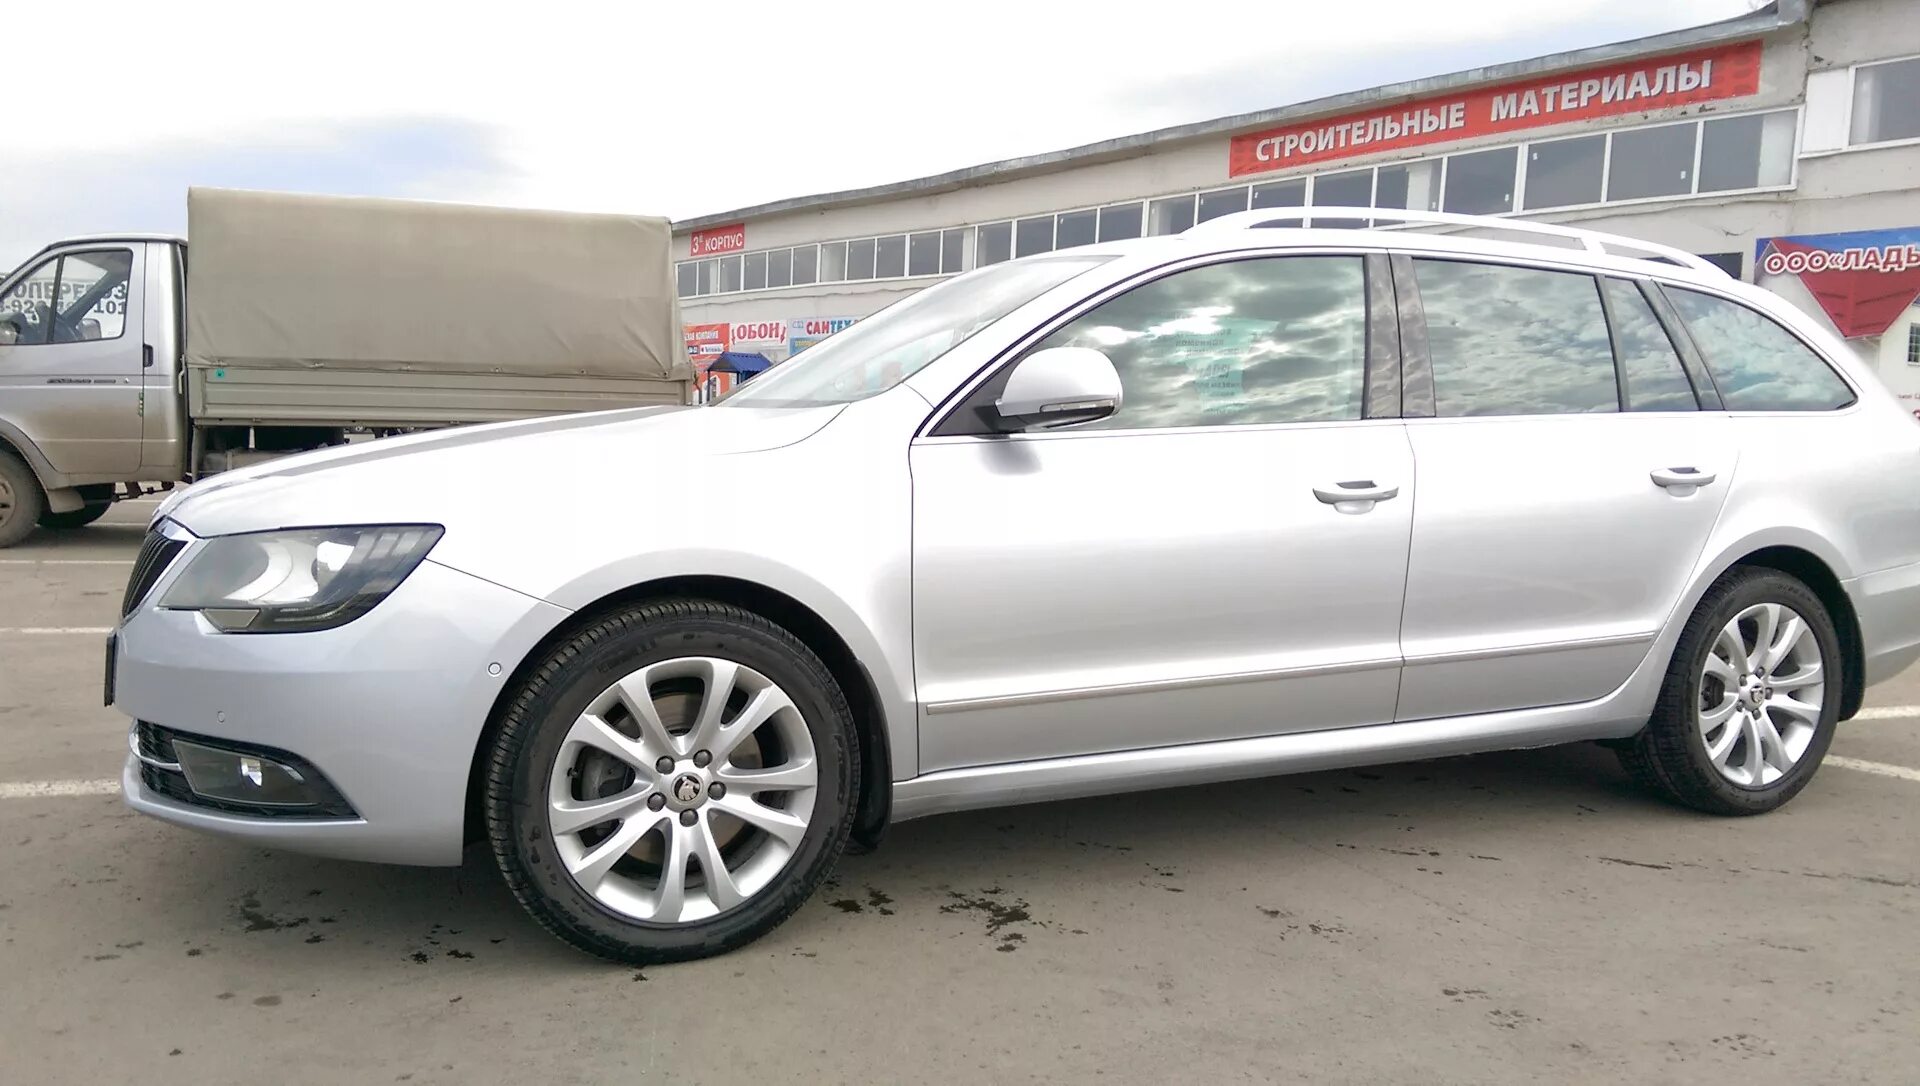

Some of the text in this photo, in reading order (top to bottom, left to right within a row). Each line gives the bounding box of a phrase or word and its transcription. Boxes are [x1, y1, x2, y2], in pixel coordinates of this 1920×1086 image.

[1256, 59, 1713, 162] СТРОИТЕЛЬНЫЕ МАТЕРИАЛЫ
[705, 232, 743, 252] КОРПУС
